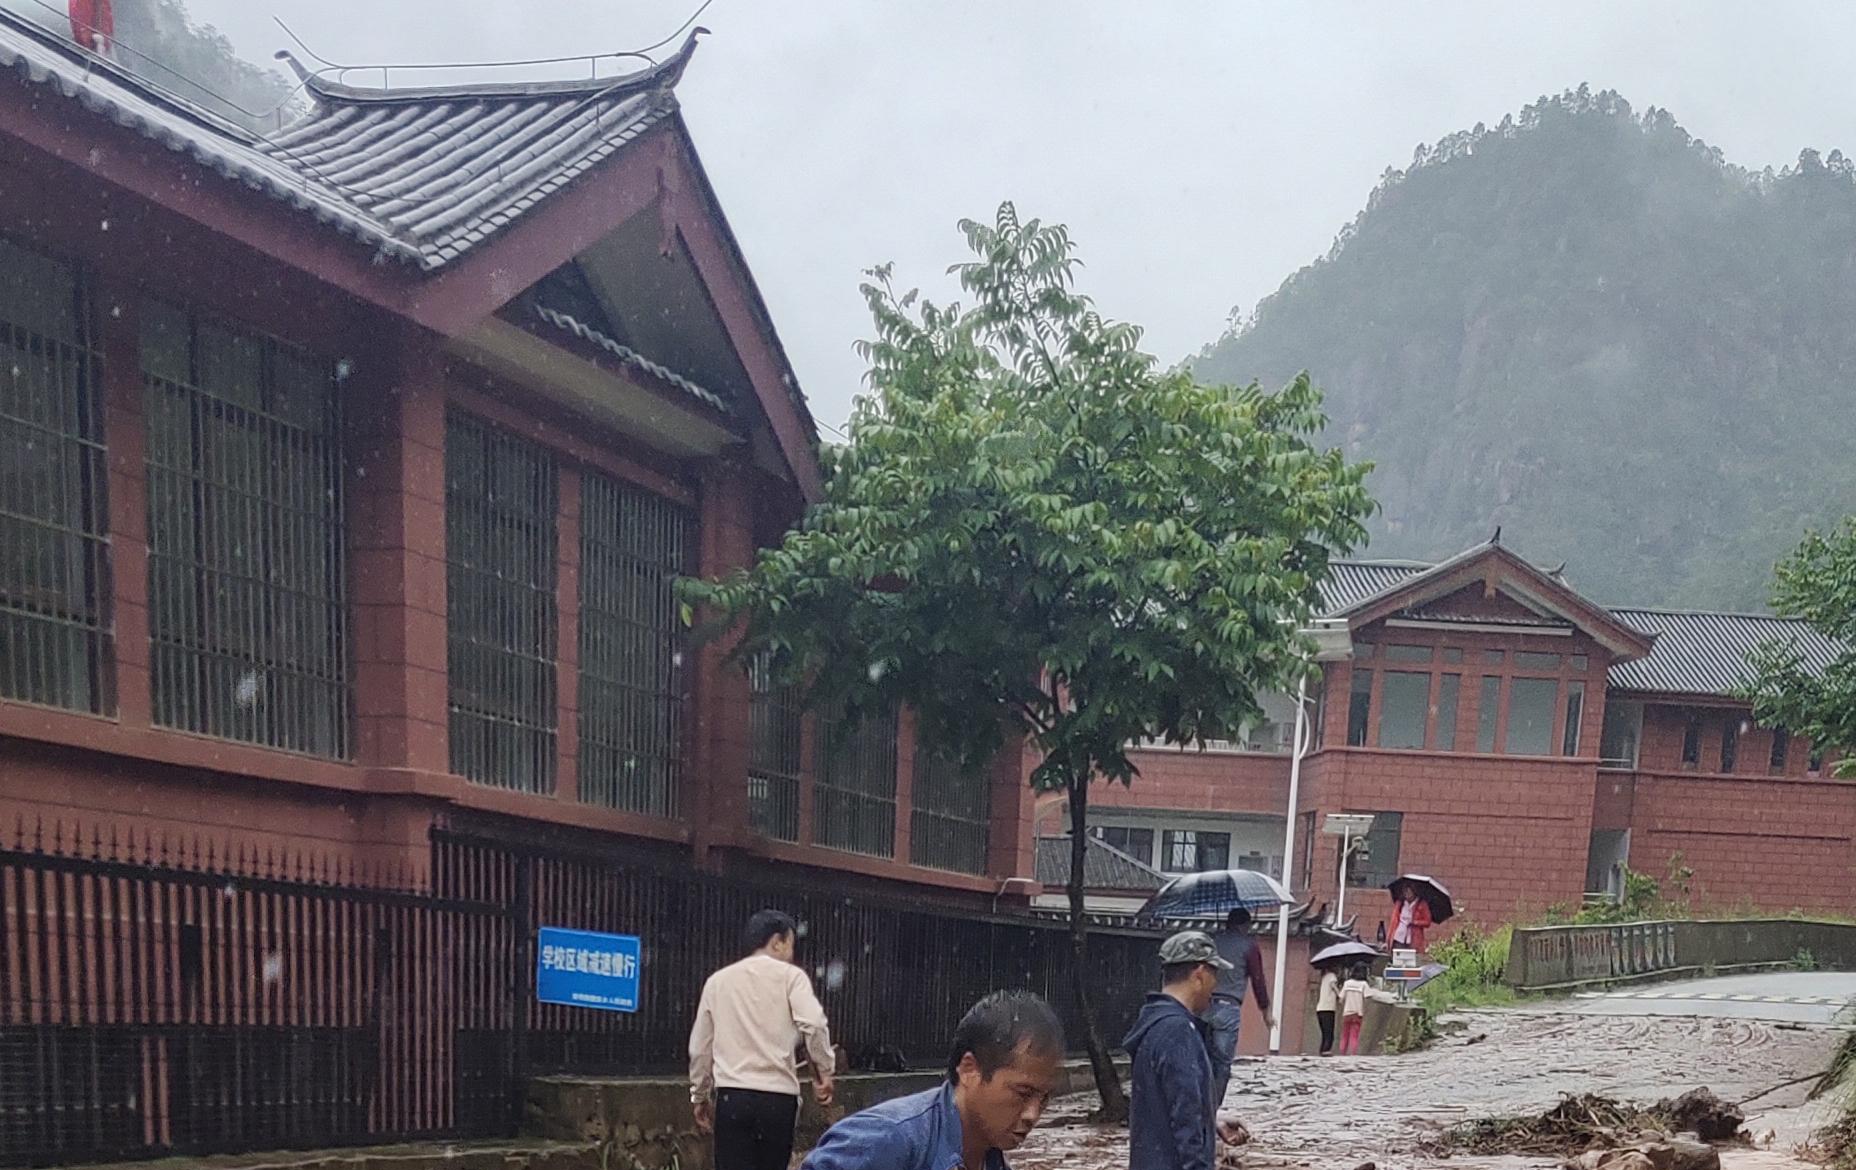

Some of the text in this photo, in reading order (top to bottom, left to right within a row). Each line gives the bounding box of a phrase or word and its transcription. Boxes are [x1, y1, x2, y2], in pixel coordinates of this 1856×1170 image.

[542, 945, 635, 978] 学校区域减速慢行
